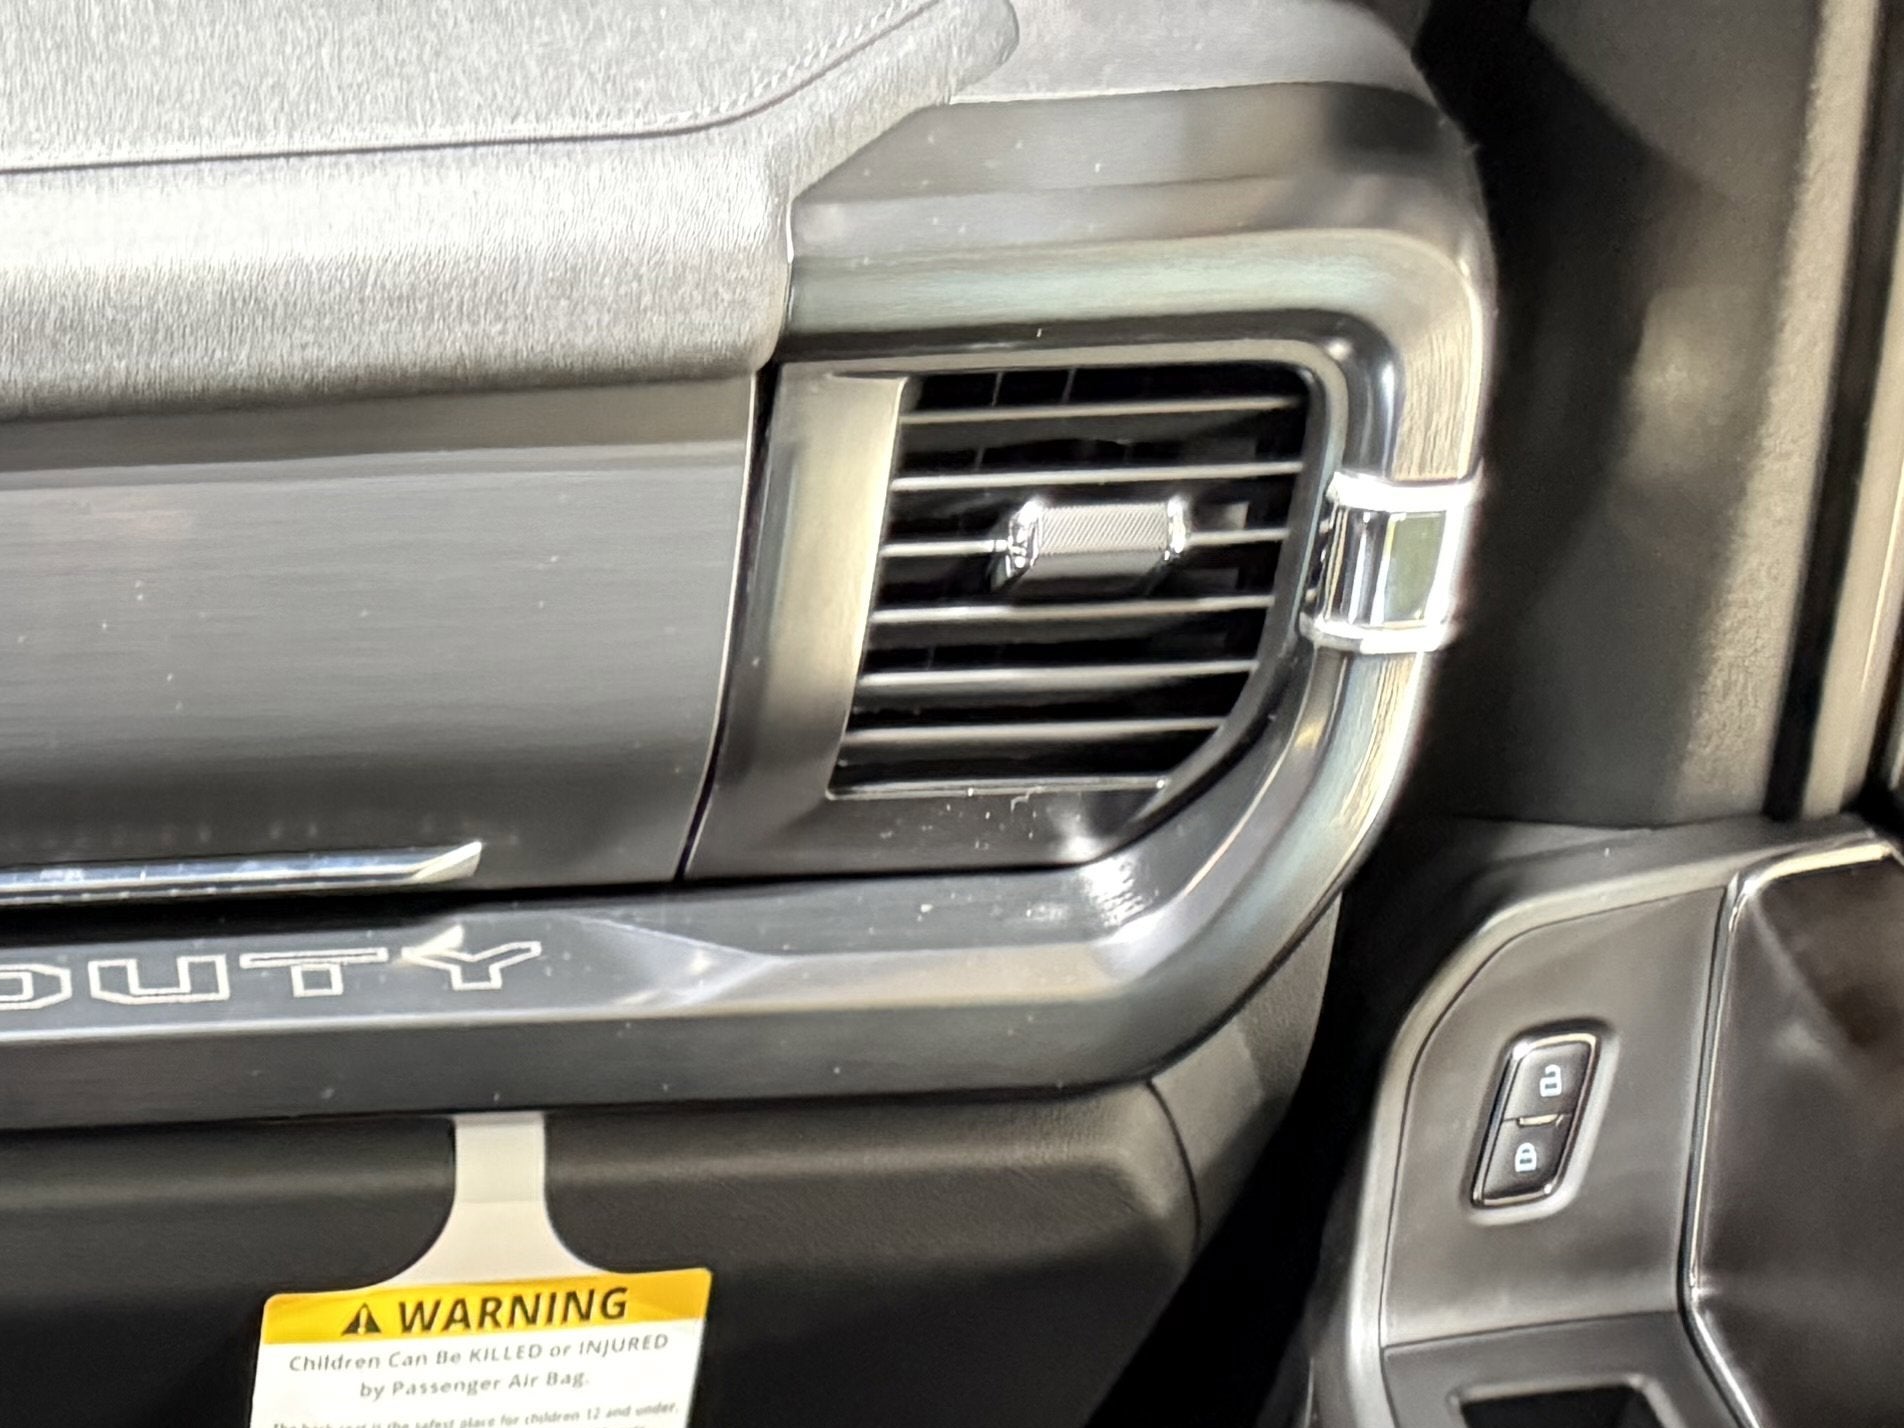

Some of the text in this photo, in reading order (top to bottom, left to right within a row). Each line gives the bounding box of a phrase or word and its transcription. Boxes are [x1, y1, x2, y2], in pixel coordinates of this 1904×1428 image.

[398, 1286, 629, 1334] WARNING
[289, 1333, 670, 1372] Children Can Be KILLED or INJURED
[360, 1370, 590, 1403] by Passenger Air Bag.
[500, 1413, 519, 1428] for
[524, 1410, 580, 1426] children
[586, 1406, 601, 1421] 12
[606, 1405, 631, 1419] and
